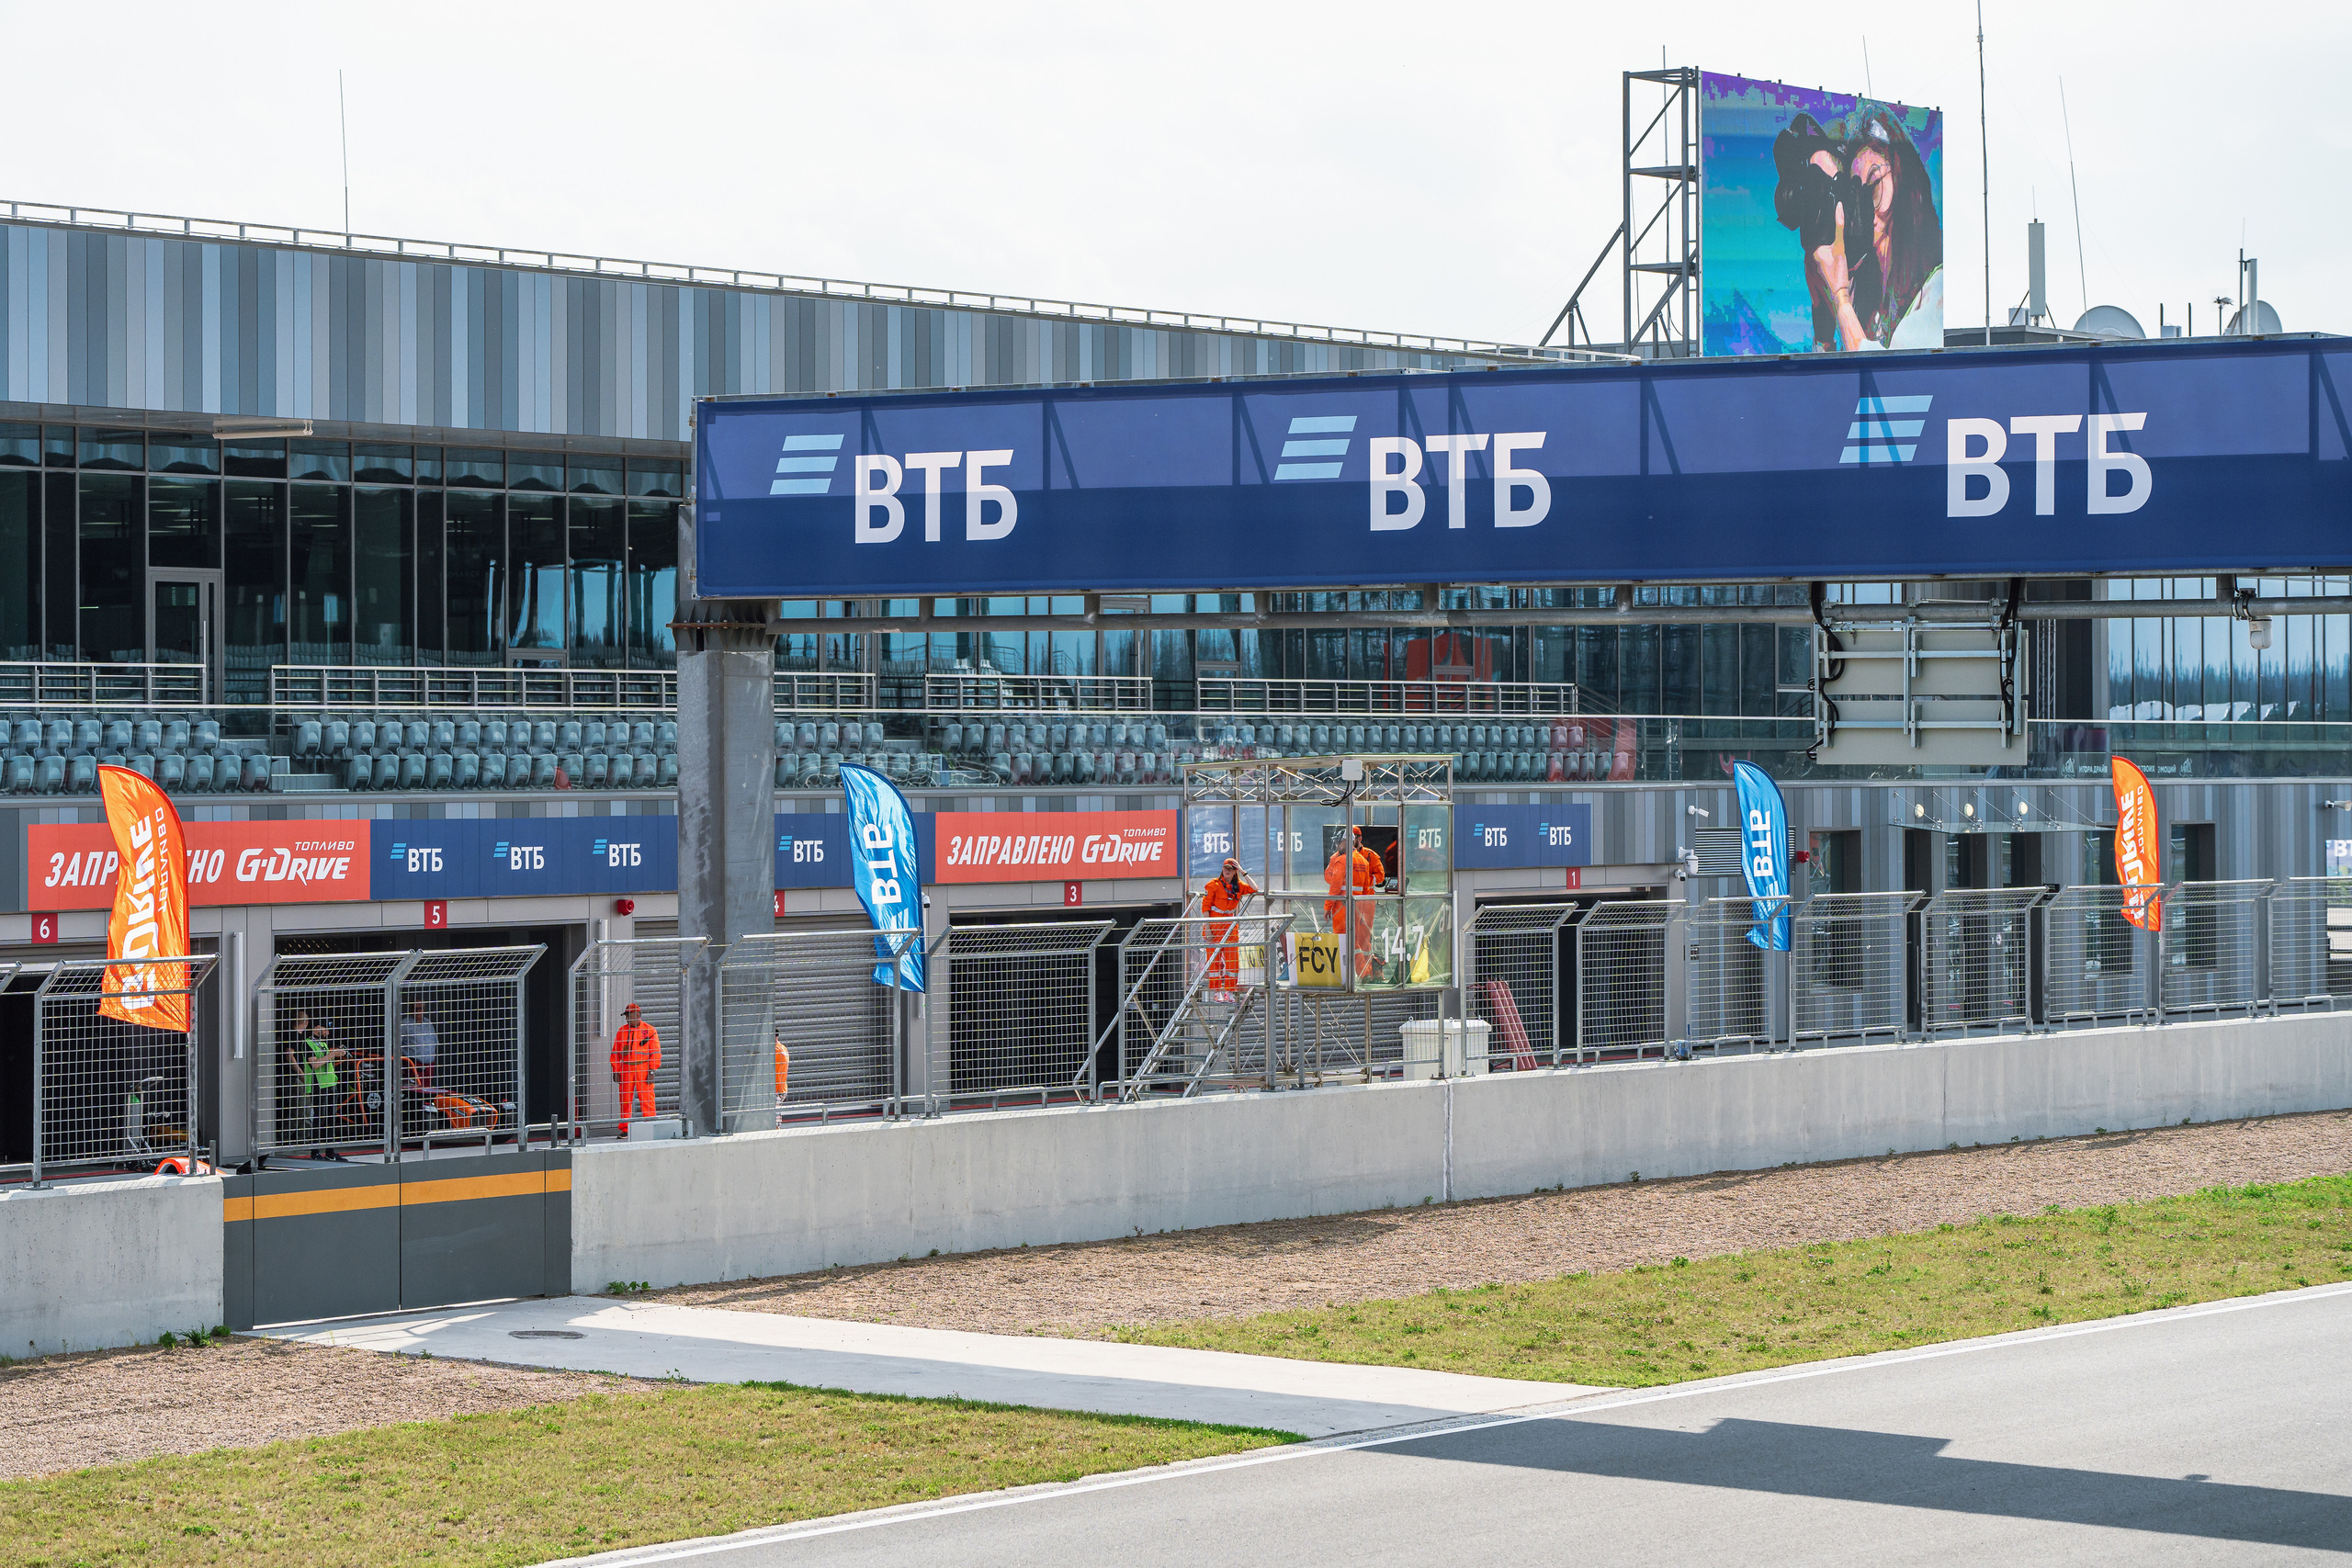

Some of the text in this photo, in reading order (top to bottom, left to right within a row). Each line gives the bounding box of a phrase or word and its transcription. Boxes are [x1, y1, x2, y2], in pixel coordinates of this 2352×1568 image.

[1947, 412, 2153, 518] ВТБ
[1369, 431, 1552, 532] ВТБ
[854, 448, 1019, 544] ВТБ
[1123, 827, 1167, 838] ТОПЛИВО
[1204, 831, 1231, 853] ВТБ
[1418, 829, 1442, 849] ВТБ
[1485, 827, 1508, 847] ВТБ
[1550, 826, 1572, 846] ВТБ
[294, 840, 355, 852] ТОПЛИВО
[608, 842, 642, 867] ВТБ
[792, 840, 824, 863] ВТБ
[946, 835, 1075, 865] ЗАПРАВЛЕНО
[44, 848, 226, 888] ЗАПРНО
[408, 847, 444, 873] ВТБ
[510, 845, 545, 871] ВТБ
[1571, 872, 1577, 886] 1
[1069, 885, 1078, 903] 3
[431, 905, 441, 925] 5
[39, 918, 51, 939] 6
[1381, 925, 1425, 963] 14.7
[1298, 946, 1339, 974] FCY
